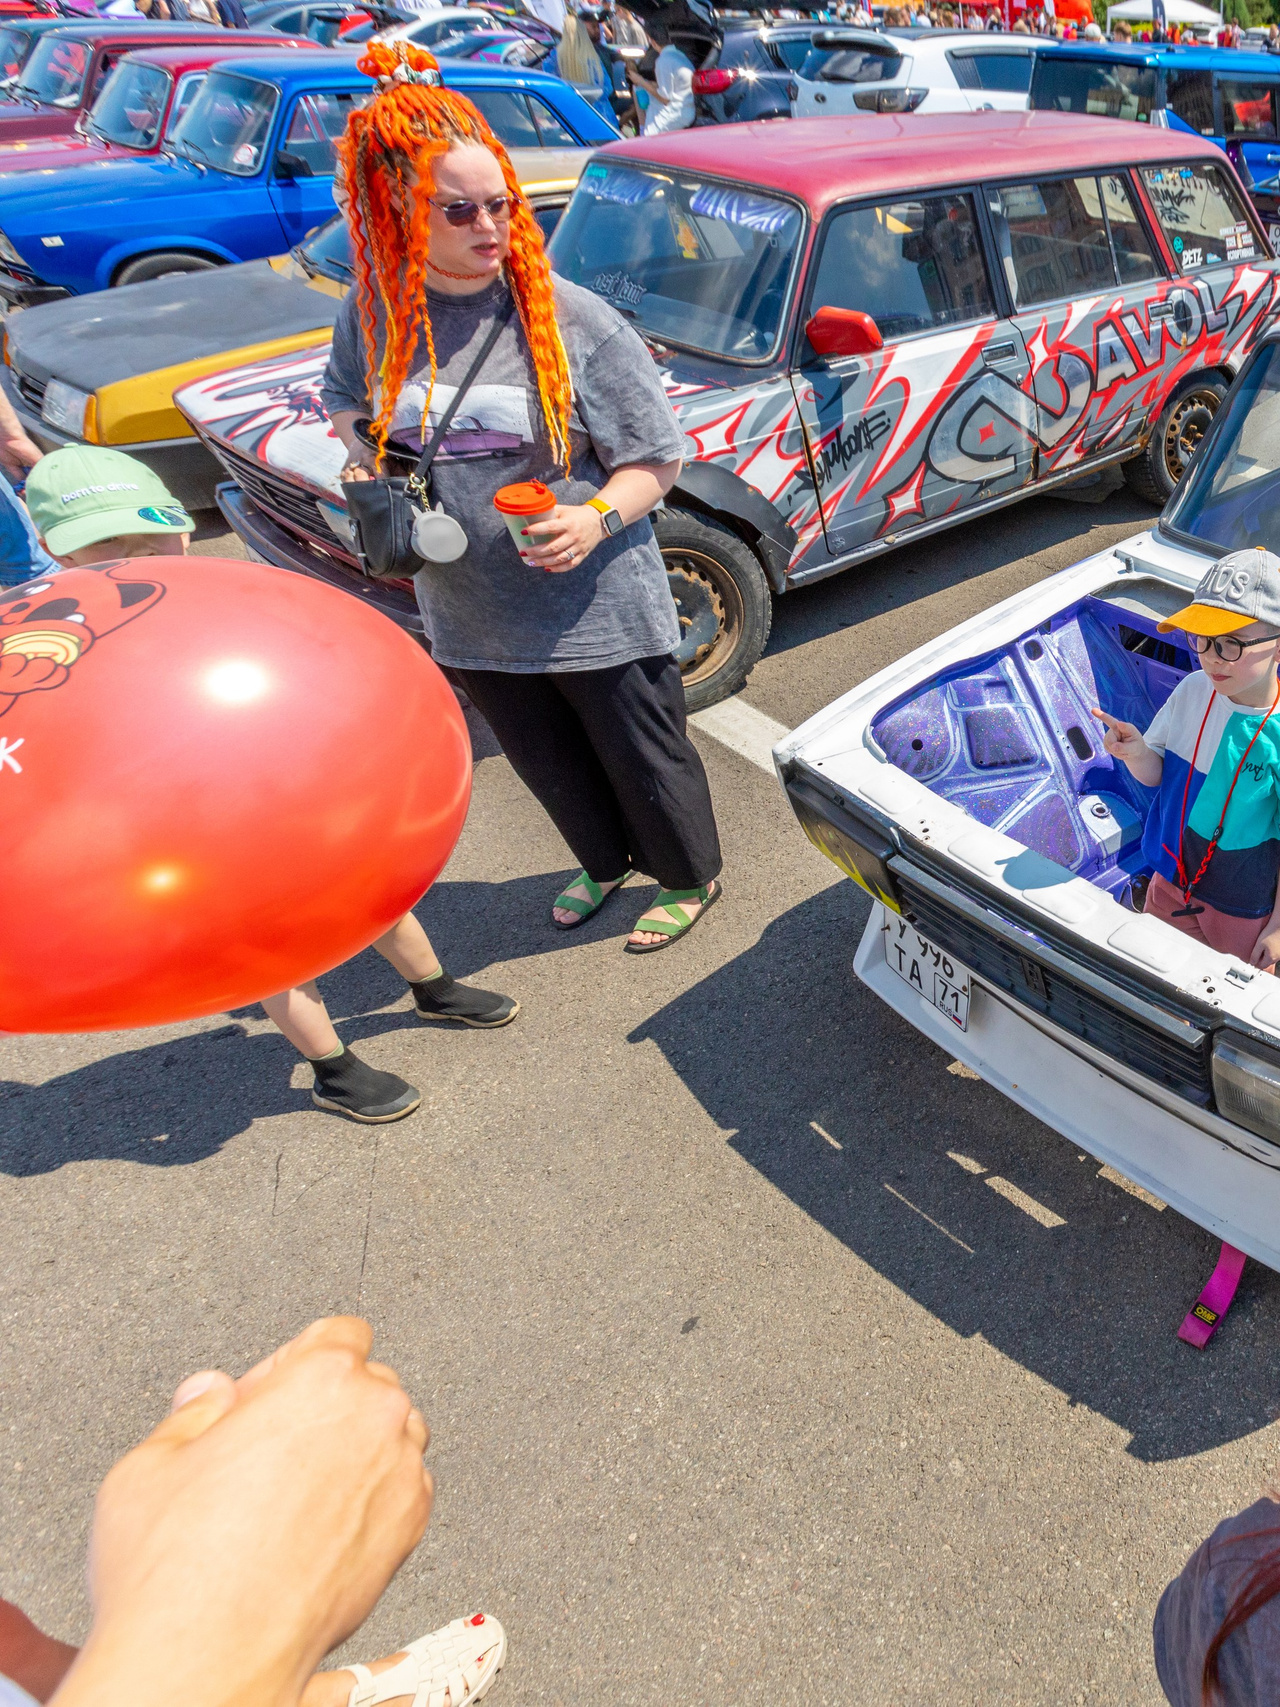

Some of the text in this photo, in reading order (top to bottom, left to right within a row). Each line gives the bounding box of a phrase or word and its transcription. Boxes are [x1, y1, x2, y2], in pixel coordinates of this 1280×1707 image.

[62, 482, 140, 505] born to drive
[939, 979, 960, 1013] 71
[939, 1001, 953, 1017] RUS
[1195, 1307, 1216, 1321] OMP
